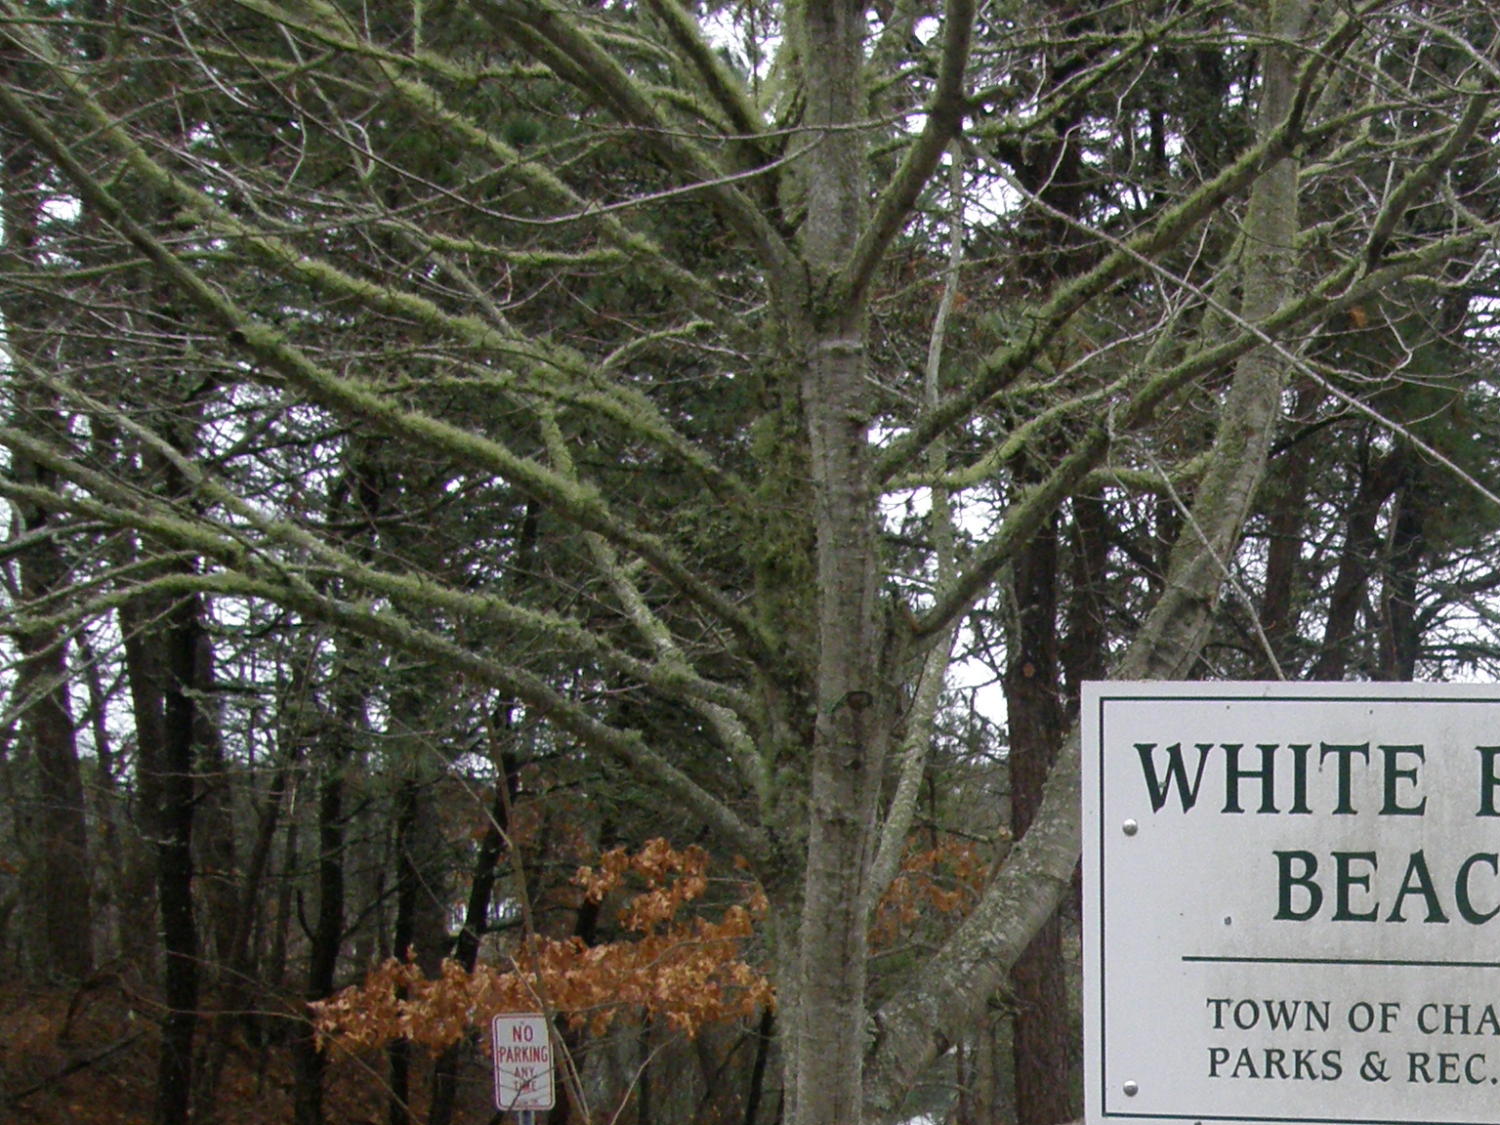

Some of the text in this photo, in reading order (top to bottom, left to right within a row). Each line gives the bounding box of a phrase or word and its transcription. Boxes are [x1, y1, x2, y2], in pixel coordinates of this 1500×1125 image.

[1133, 741, 1428, 817] WHITE
[1206, 998, 1331, 1032] TOWN
[1348, 1001, 1401, 1033] OF
[512, 1025, 534, 1042] NO
[500, 1045, 548, 1063] PARKING
[1208, 1047, 1343, 1081] PARKS
[1359, 1050, 1391, 1083] &
[1407, 1052, 1499, 1085] REC.
[513, 1066, 535, 1079] ANY
